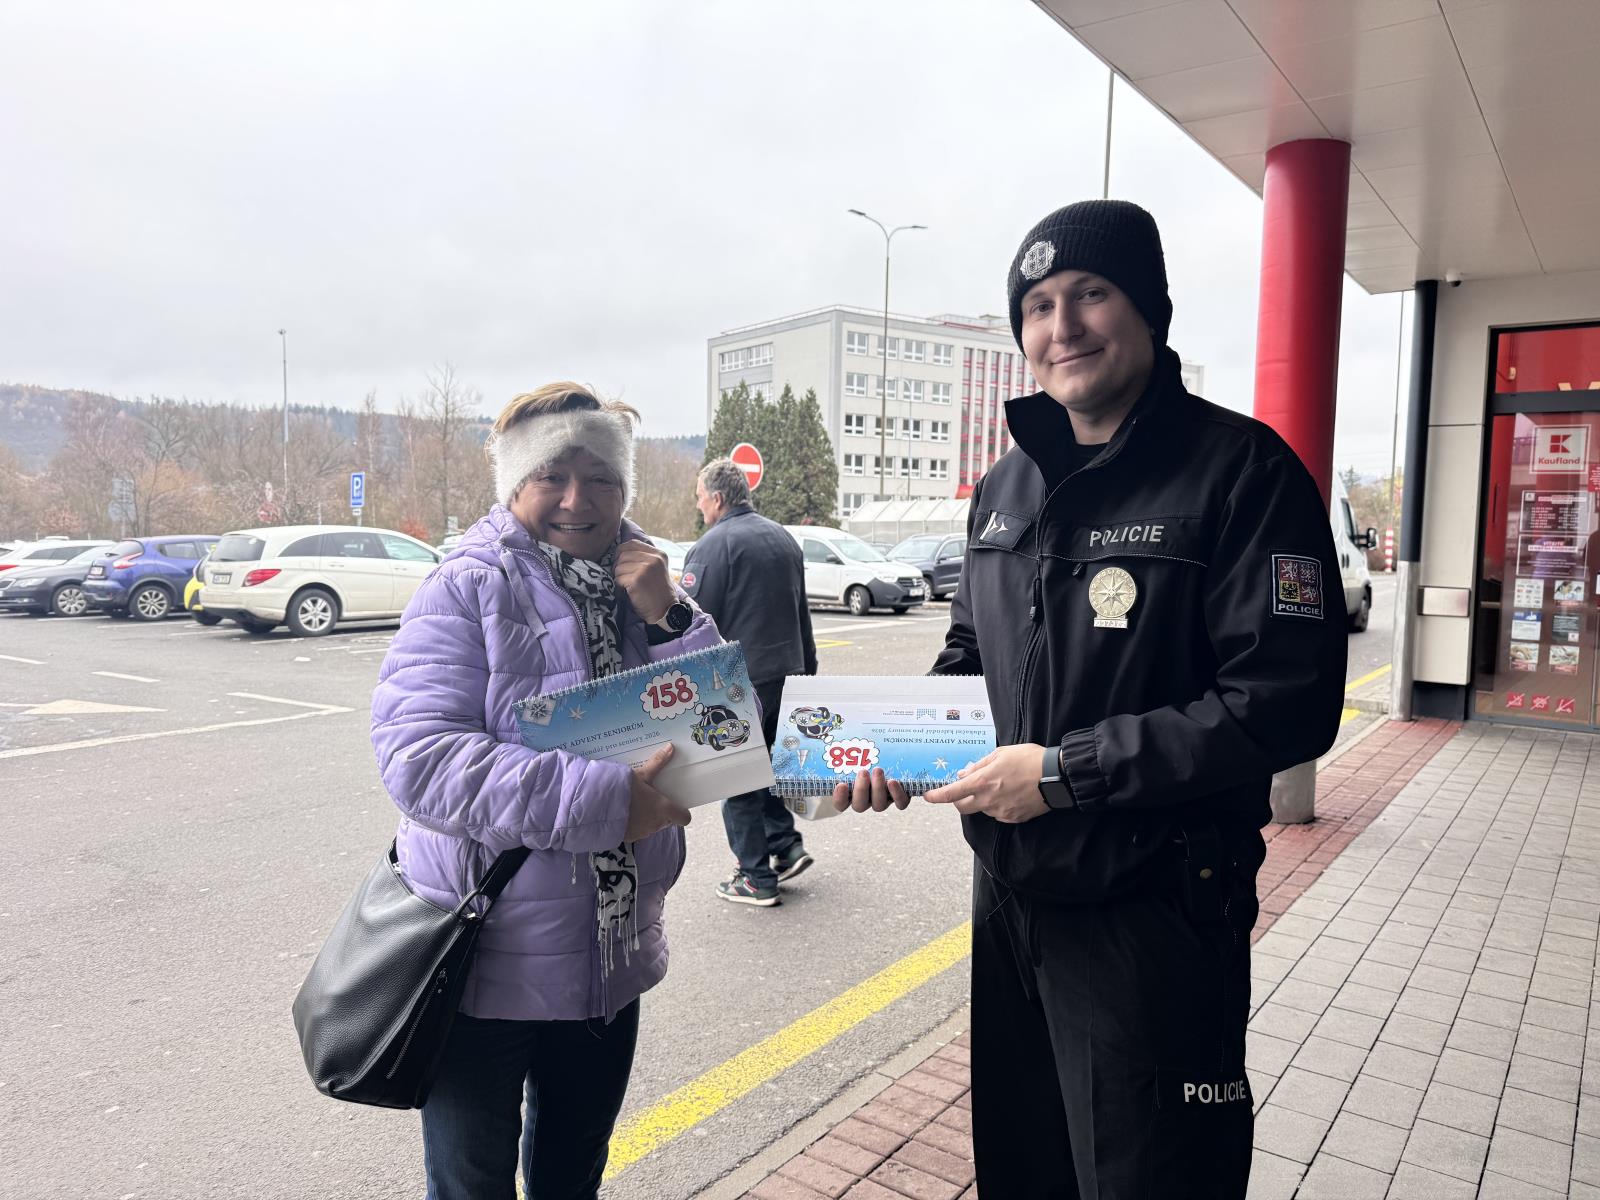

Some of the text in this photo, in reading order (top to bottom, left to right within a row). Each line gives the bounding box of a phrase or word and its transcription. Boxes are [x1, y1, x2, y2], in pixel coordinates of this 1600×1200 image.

[1538, 457, 1581, 465] Kaufland
[353, 476, 362, 497] P
[1089, 525, 1165, 547] POLICIE
[1278, 603, 1321, 615] POLICIE
[647, 677, 694, 709] 158
[570, 733, 603, 748] ADVENT
[605, 741, 618, 752] pro
[618, 734, 644, 748] seniory
[644, 730, 661, 741] 2026
[925, 728, 954, 736] kalendář
[957, 738, 987, 746] KLIDNÝ
[829, 746, 872, 767] 158
[1183, 1080, 1247, 1104] POLICIE
